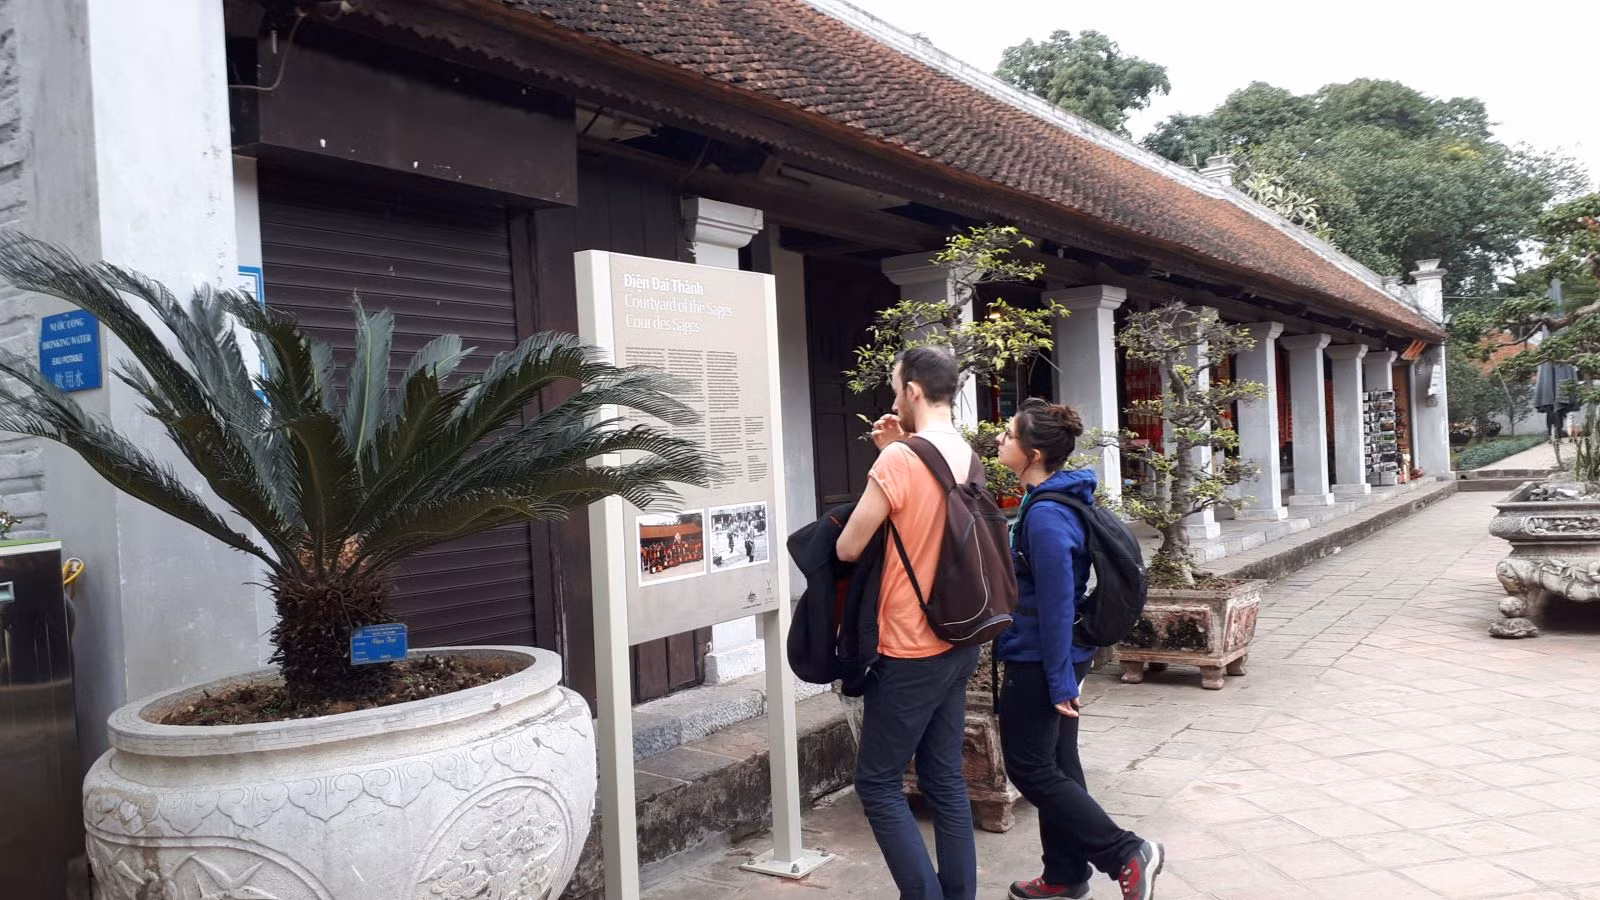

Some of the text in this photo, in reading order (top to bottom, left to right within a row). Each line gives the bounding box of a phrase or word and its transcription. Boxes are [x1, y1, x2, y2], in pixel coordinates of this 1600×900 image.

[624, 273, 704, 295] Điện Đại Thành
[625, 293, 734, 320] Courtyard of the Sages
[626, 313, 701, 335] Cour des Sages
[42, 334, 92, 350] DRINKING WATER
[63, 353, 83, 363] POTABLE
